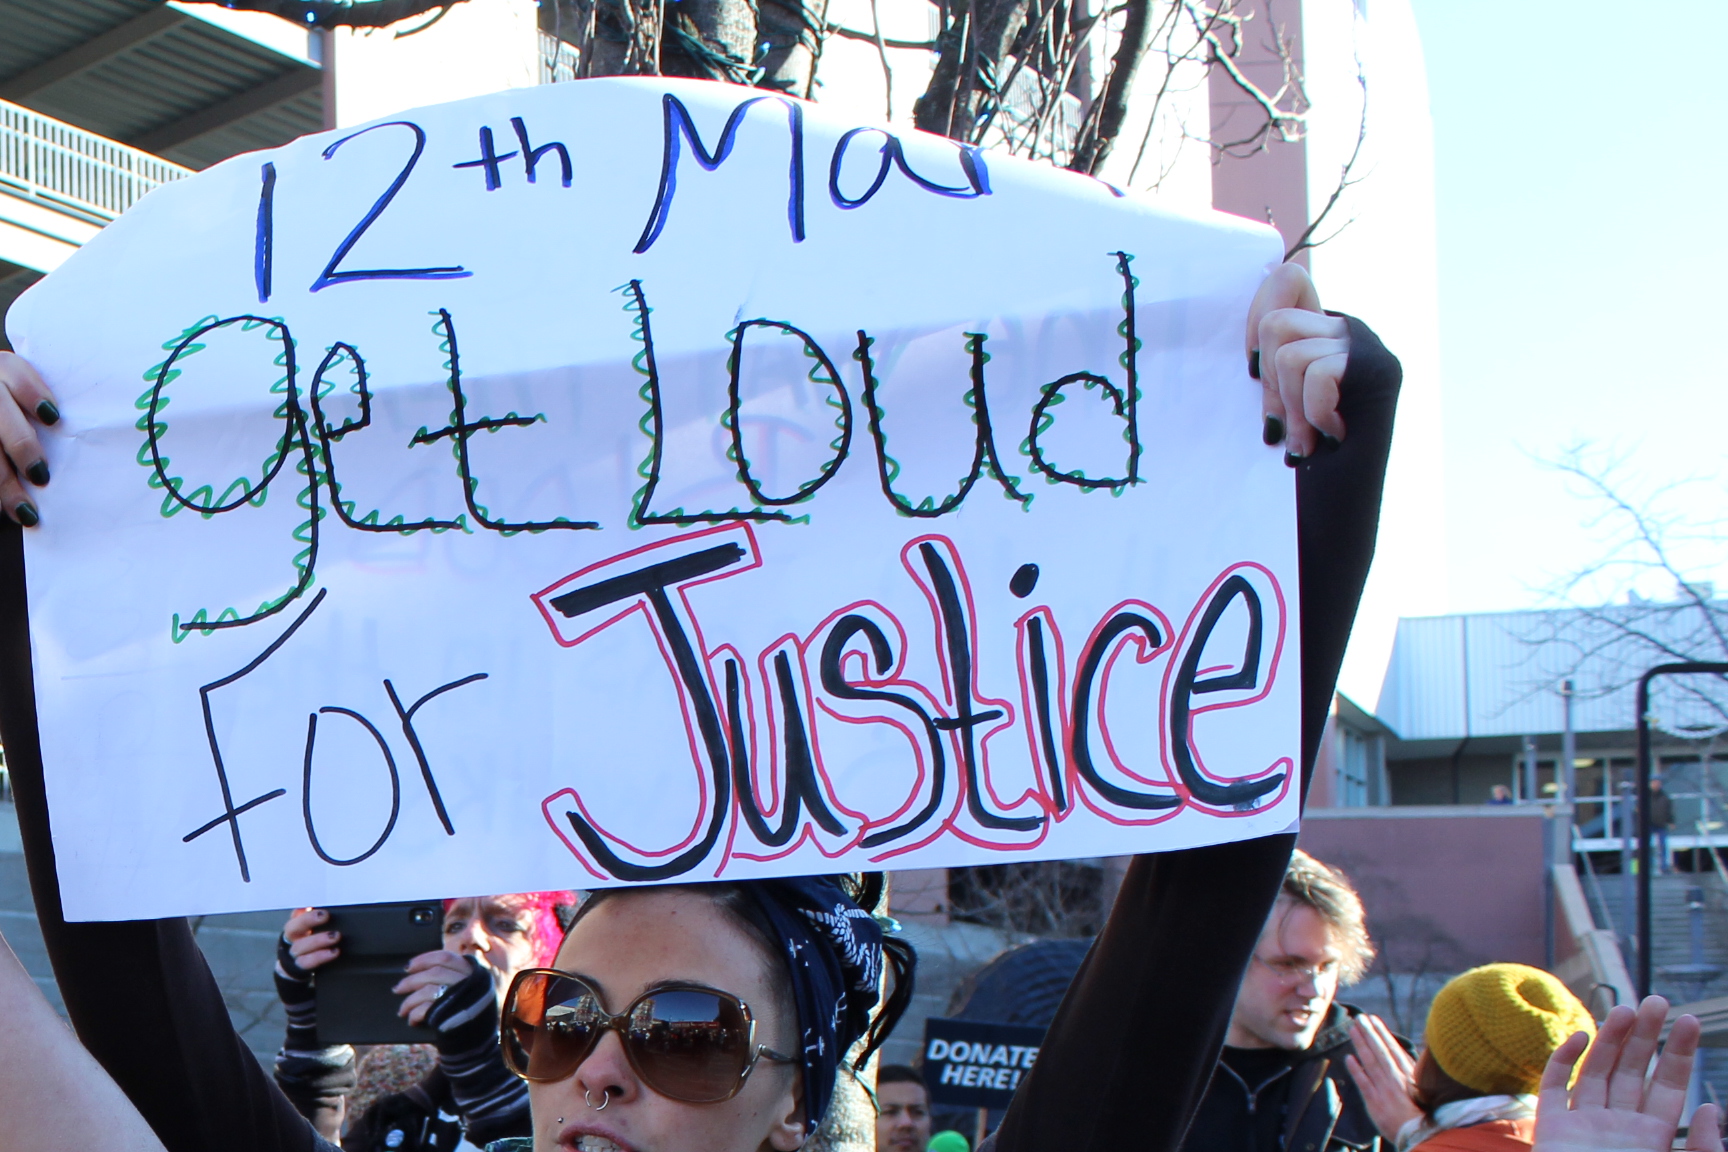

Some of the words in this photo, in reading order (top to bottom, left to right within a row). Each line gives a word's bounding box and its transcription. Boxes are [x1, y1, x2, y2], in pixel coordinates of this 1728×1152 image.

[135, 308, 603, 643] get
[184, 588, 489, 883] For
[532, 519, 1293, 883] Justice
[927, 1038, 1041, 1070] DONATE
[940, 1063, 1022, 1091] HERE!
